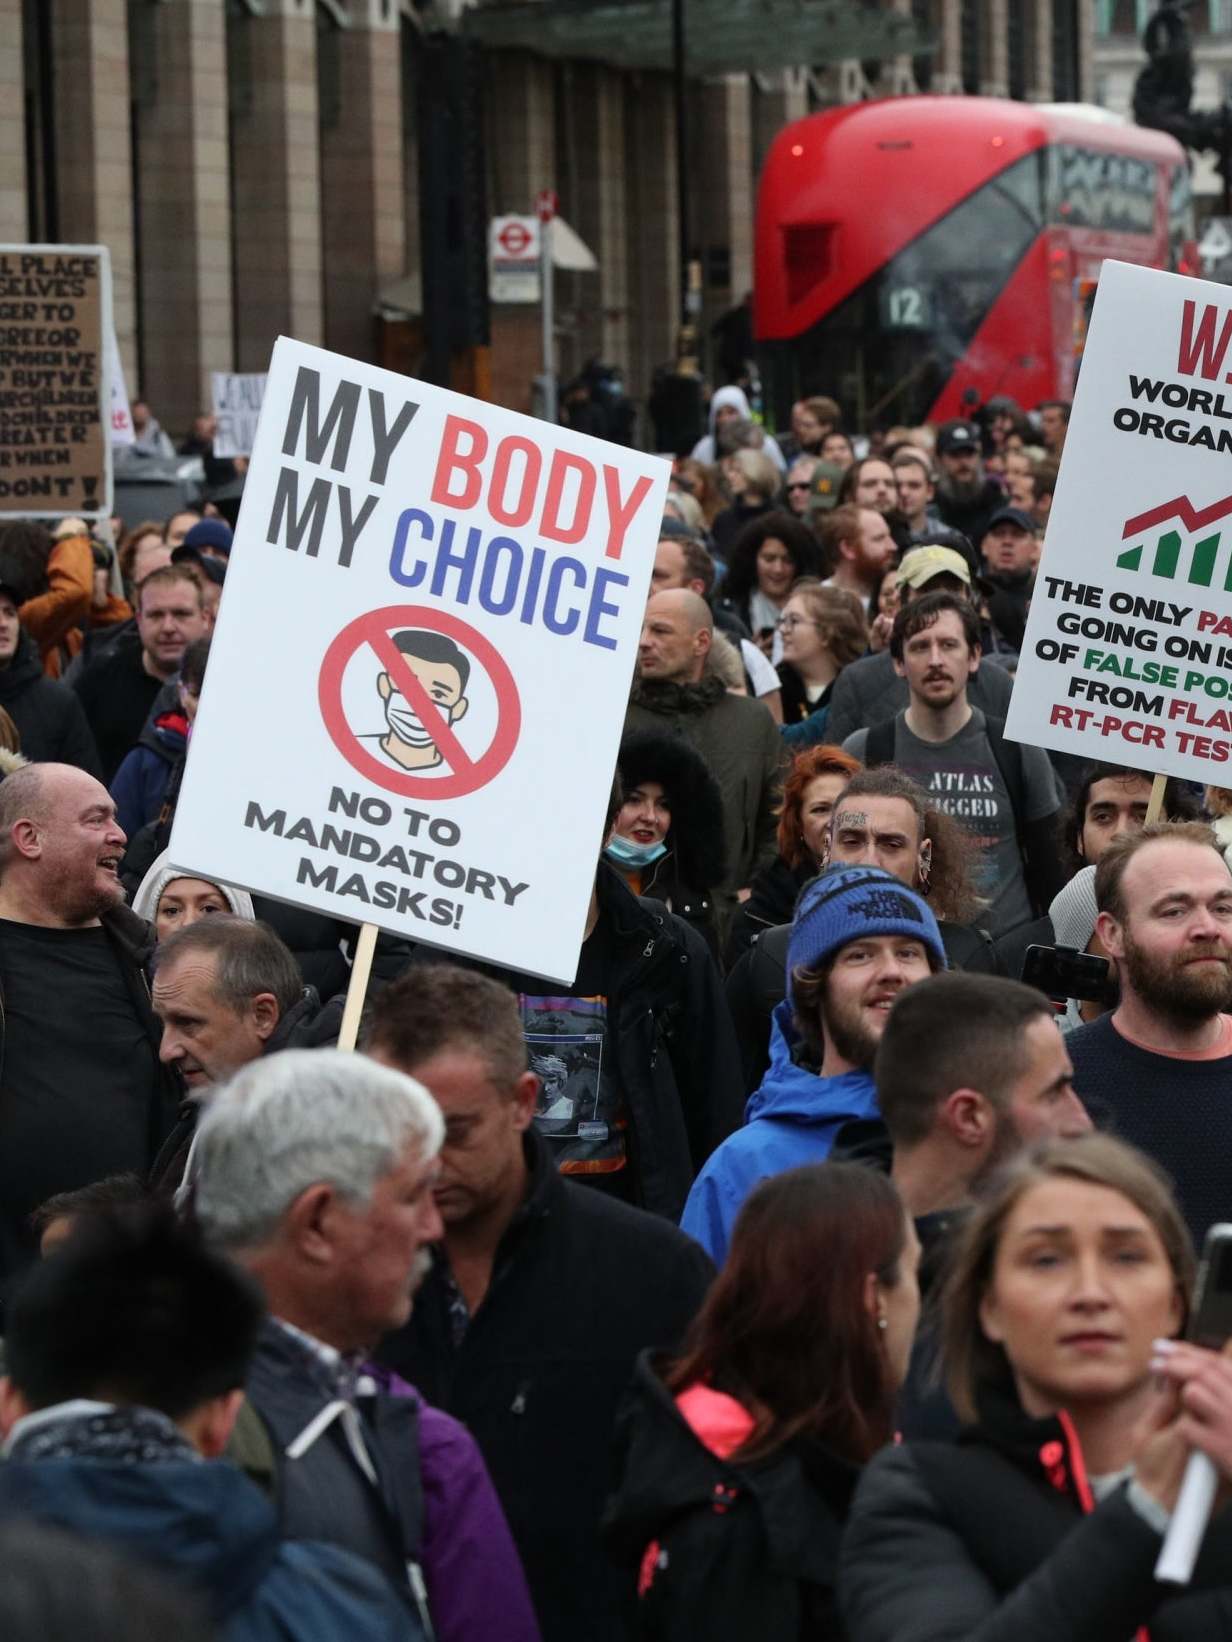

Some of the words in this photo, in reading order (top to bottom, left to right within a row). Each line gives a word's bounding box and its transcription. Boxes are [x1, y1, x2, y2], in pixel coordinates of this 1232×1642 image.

[21, 255, 97, 278] PLACE
[40, 302, 75, 322] TO
[890, 288, 922, 324] 12
[12, 370, 57, 387] BUT
[59, 370, 93, 386] WE
[67, 352, 97, 371] WE
[281, 365, 421, 486] MY
[430, 414, 655, 559] BODY
[266, 467, 380, 568] MY
[389, 508, 629, 651] CHOICE
[1044, 576, 1103, 609] THE
[1108, 592, 1193, 627] ONLY
[1056, 612, 1158, 652] GOING
[1164, 636, 1213, 665] ON
[1035, 639, 1080, 665] OF
[1082, 649, 1180, 689] FALSE
[1067, 677, 1165, 717] FROM
[1049, 704, 1166, 749] RT-PCR
[928, 771, 994, 793] ATLAS
[327, 785, 392, 826] NO
[402, 807, 461, 847] TO
[243, 801, 530, 907] MANDATORY
[296, 857, 463, 930] MASKS!
